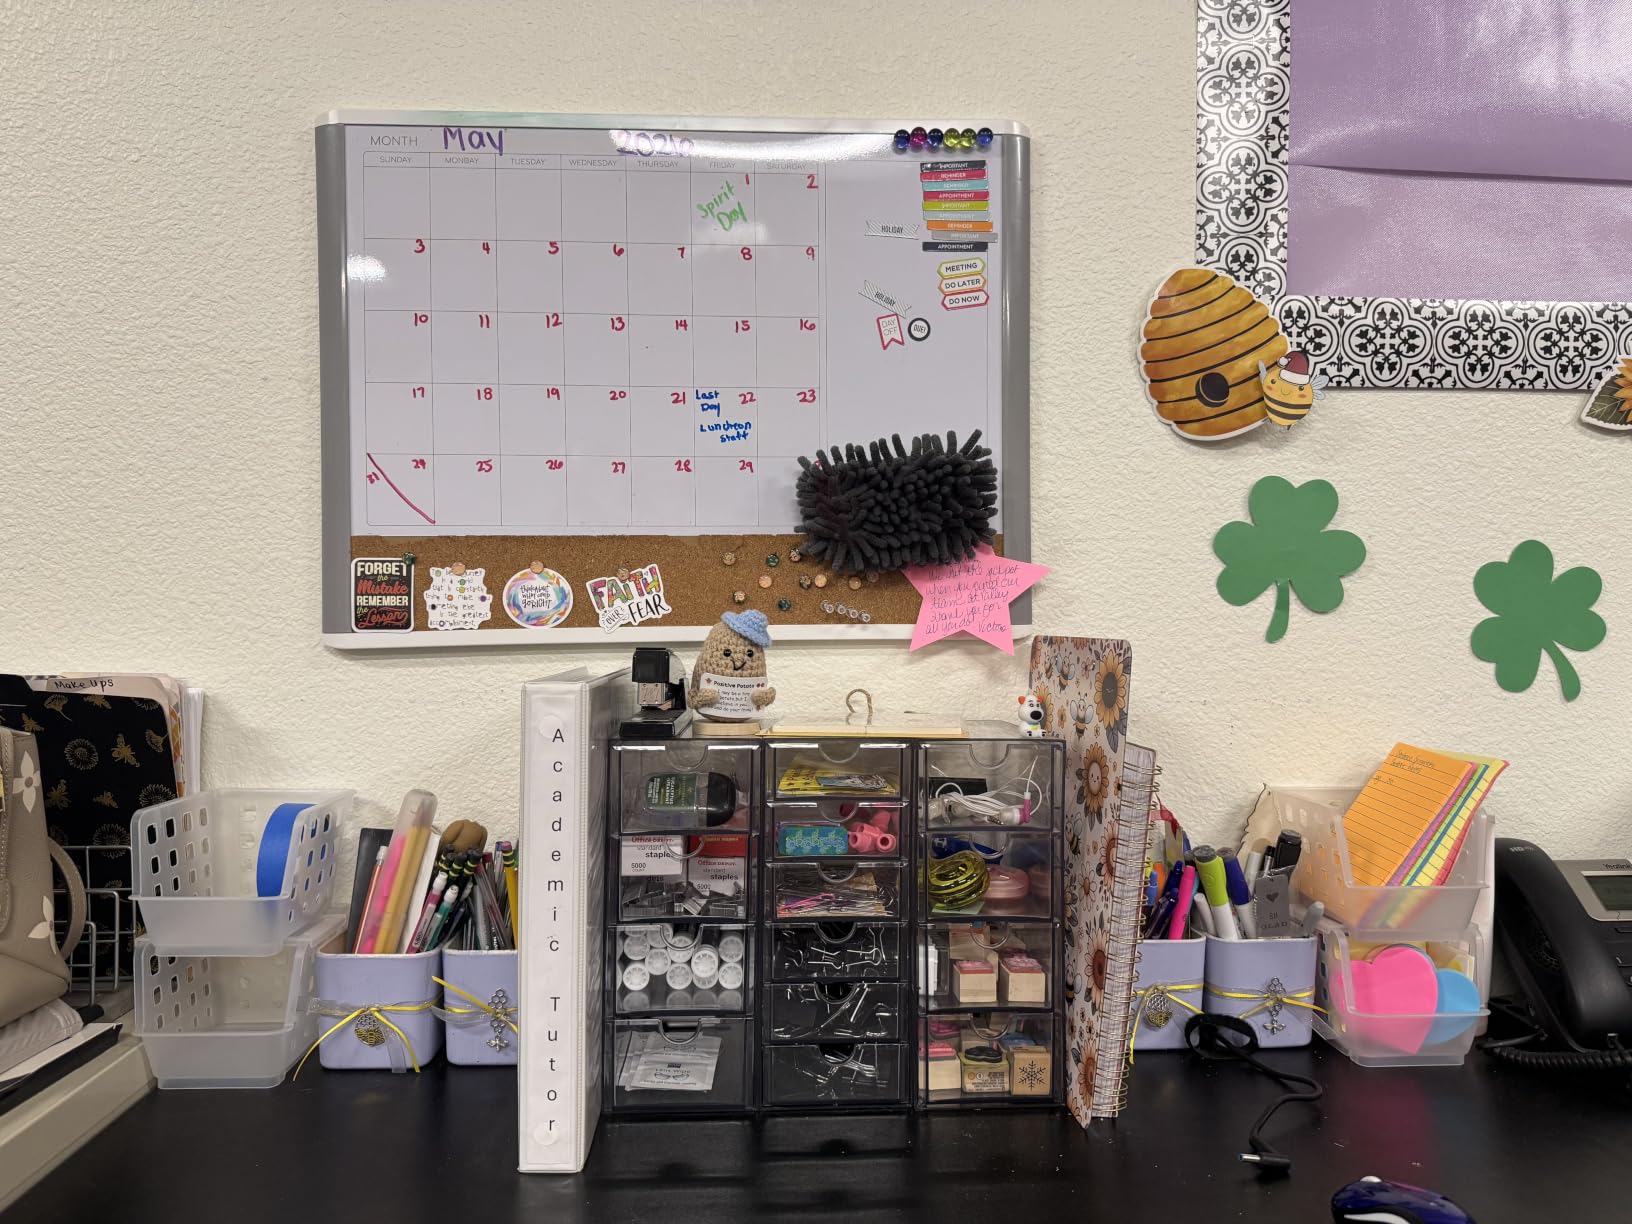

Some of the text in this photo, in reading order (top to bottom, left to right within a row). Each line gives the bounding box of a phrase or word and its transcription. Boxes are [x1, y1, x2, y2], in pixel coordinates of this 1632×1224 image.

[370, 135, 418, 147] MONTH
[443, 126, 504, 157] May
[379, 156, 412, 164] SUNDAY
[445, 157, 479, 165] MONDAY
[569, 159, 617, 167] WEDNESDAY
[638, 160, 679, 168] THURSDAY
[709, 161, 736, 169] FRIDAY
[766, 162, 807, 171] SATURDAY
[939, 162, 969, 170] IMPORTANT
[744, 173, 750, 185] 1
[806, 174, 819, 189] 2
[696, 180, 736, 219] Spirit
[715, 201, 748, 232] Day
[881, 225, 904, 235] HOLIDAY
[413, 238, 426, 253] 3
[482, 241, 491, 255] 4
[548, 240, 560, 255] 5
[612, 243, 625, 256] 6
[677, 246, 686, 259] 7
[741, 246, 753, 261] 8
[805, 246, 816, 261] 9
[945, 262, 978, 273] MEETING
[944, 278, 981, 290] DO LATER
[874, 290, 896, 307] HOLIDAY
[948, 295, 980, 305] DO NOW
[413, 312, 429, 327] 10
[478, 314, 491, 328] 11
[545, 312, 563, 328] 12
[610, 316, 626, 332] 13
[675, 319, 689, 331] 14
[735, 319, 751, 334] 15
[799, 318, 817, 332] 16
[882, 319, 896, 329] DAY
[883, 326, 898, 337] OFF
[411, 386, 426, 399] 17
[476, 387, 493, 401] 18
[545, 387, 561, 401] 19
[609, 389, 627, 400] 20
[671, 391, 686, 405] 21
[695, 389, 720, 400] Last
[738, 391, 757, 405] 22
[796, 388, 817, 403] 23
[701, 402, 720, 417] Day
[699, 420, 752, 432] Luncheon
[476, 459, 493, 473] 25
[545, 458, 564, 473] 26
[612, 461, 627, 474] 27
[674, 459, 693, 473] 28
[738, 459, 754, 473] 29
[357, 562, 408, 577] FORGET
[377, 574, 389, 582] the
[357, 579, 409, 595] Mistake
[356, 595, 409, 607] REMEMBER
[627, 593, 670, 623] FEAR
[356, 606, 369, 617] the
[605, 610, 621, 625] OVER
[54, 678, 114, 692] Make Ups
[713, 681, 736, 689] Positive
[710, 873, 739, 881] staples
[547, 728, 564, 1131] Academic Tutor
